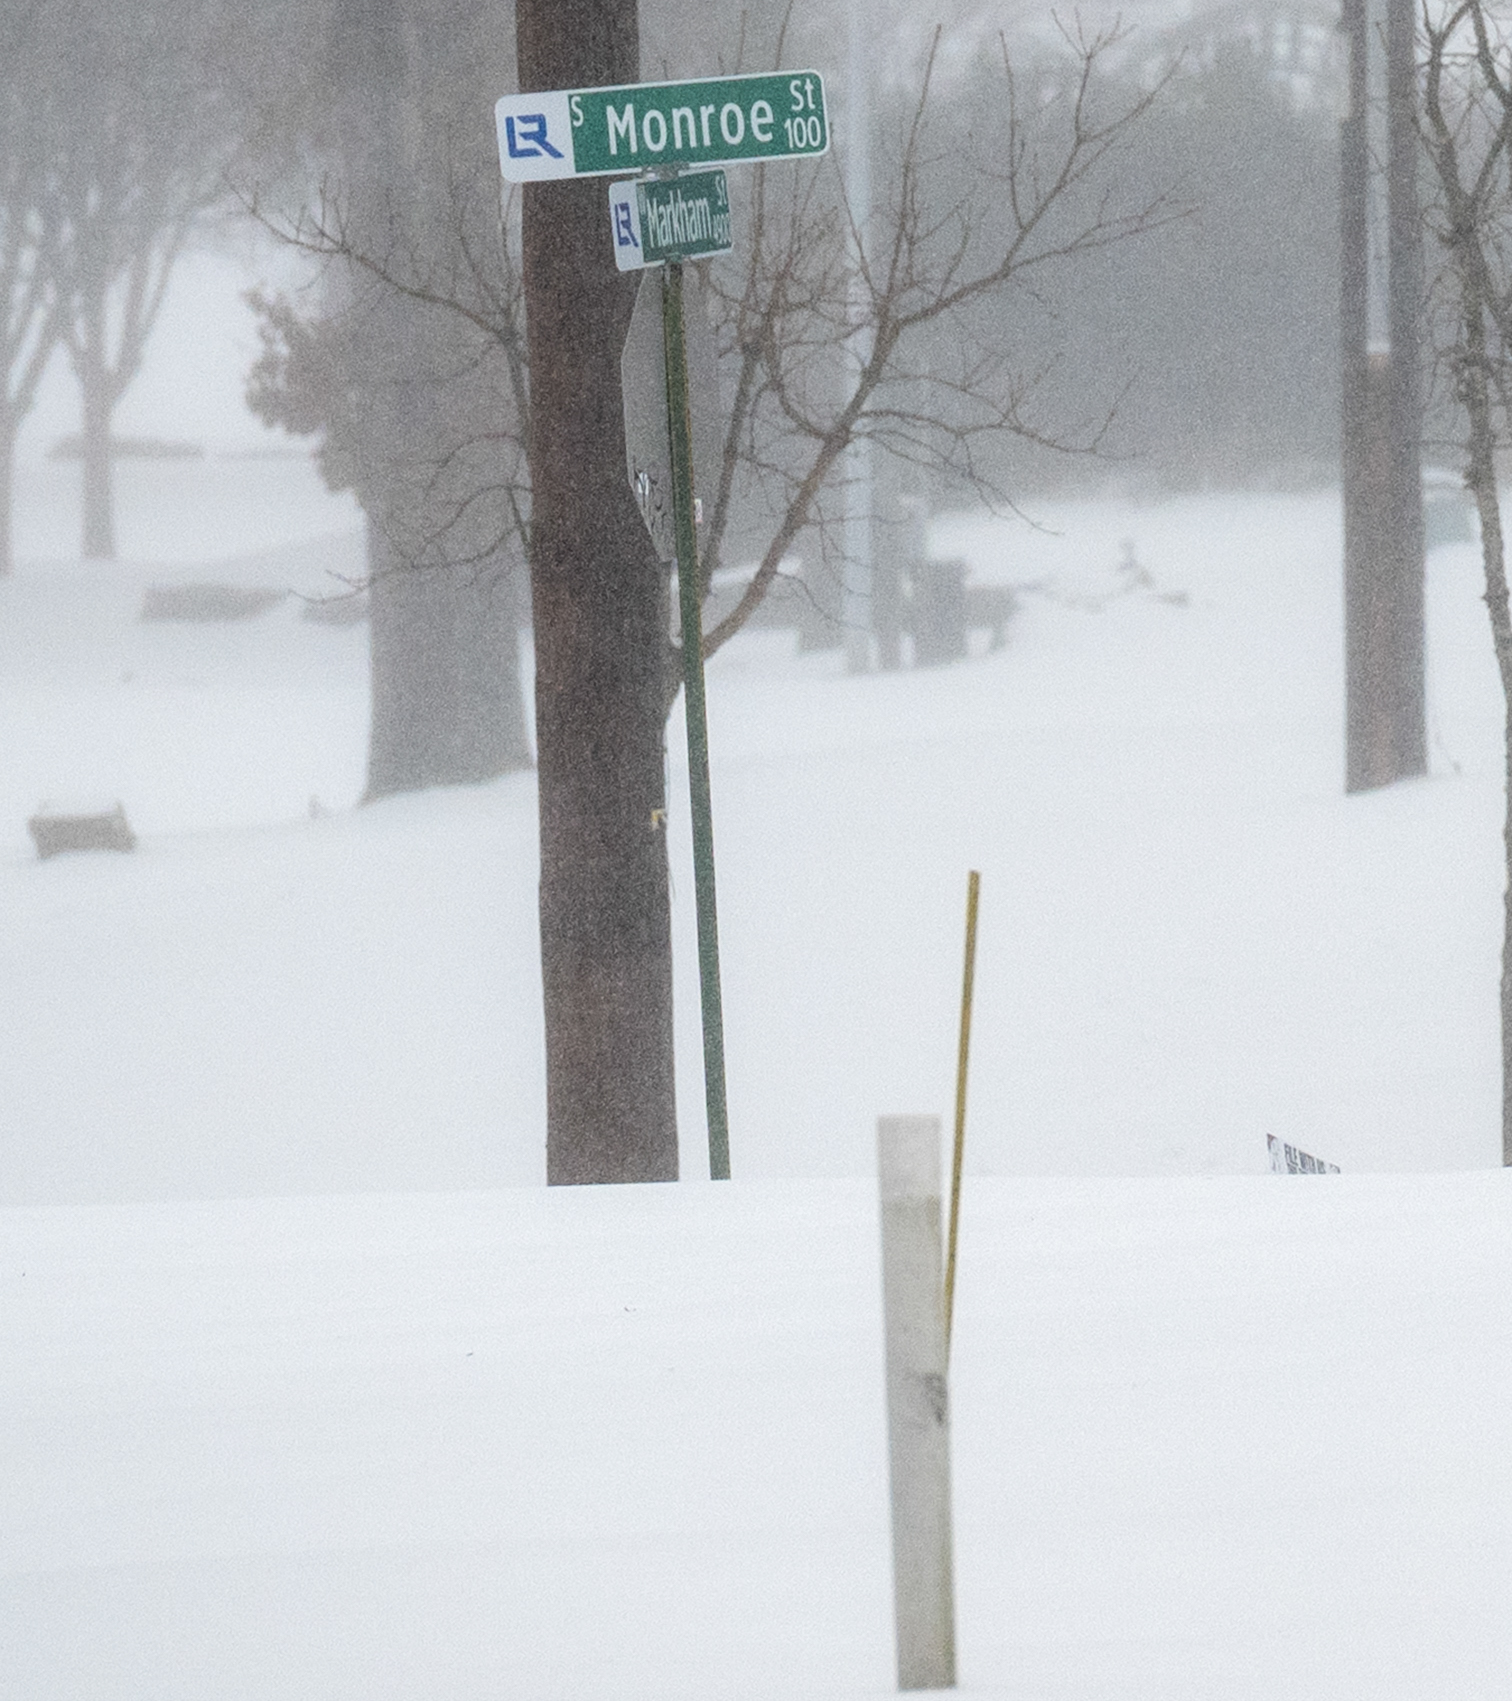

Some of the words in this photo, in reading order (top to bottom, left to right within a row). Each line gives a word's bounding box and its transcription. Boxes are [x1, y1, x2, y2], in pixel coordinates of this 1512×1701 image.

[571, 96, 585, 128] S
[606, 100, 775, 155] Monroe
[789, 78, 816, 111] St
[784, 116, 821, 149] 100
[646, 188, 712, 248] Markham
[715, 175, 728, 206] St
